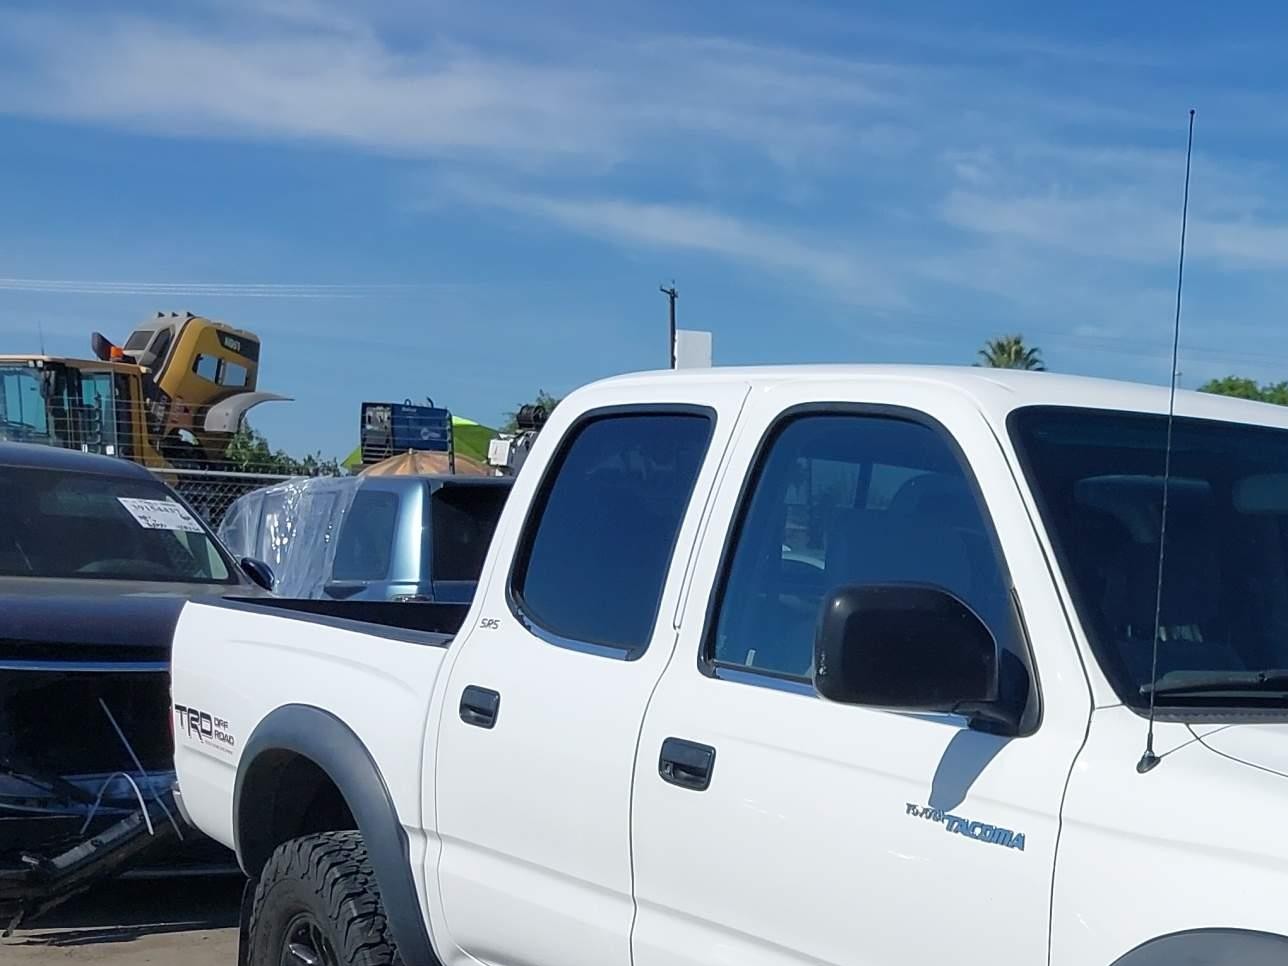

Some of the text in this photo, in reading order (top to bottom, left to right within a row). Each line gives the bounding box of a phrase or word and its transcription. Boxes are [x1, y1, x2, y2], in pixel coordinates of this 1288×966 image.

[479, 617, 500, 630] SR5
[174, 703, 213, 743] TRD
[213, 716, 229, 731] OFF
[214, 729, 235, 747] ROAD
[945, 814, 1026, 851] TACOMA
